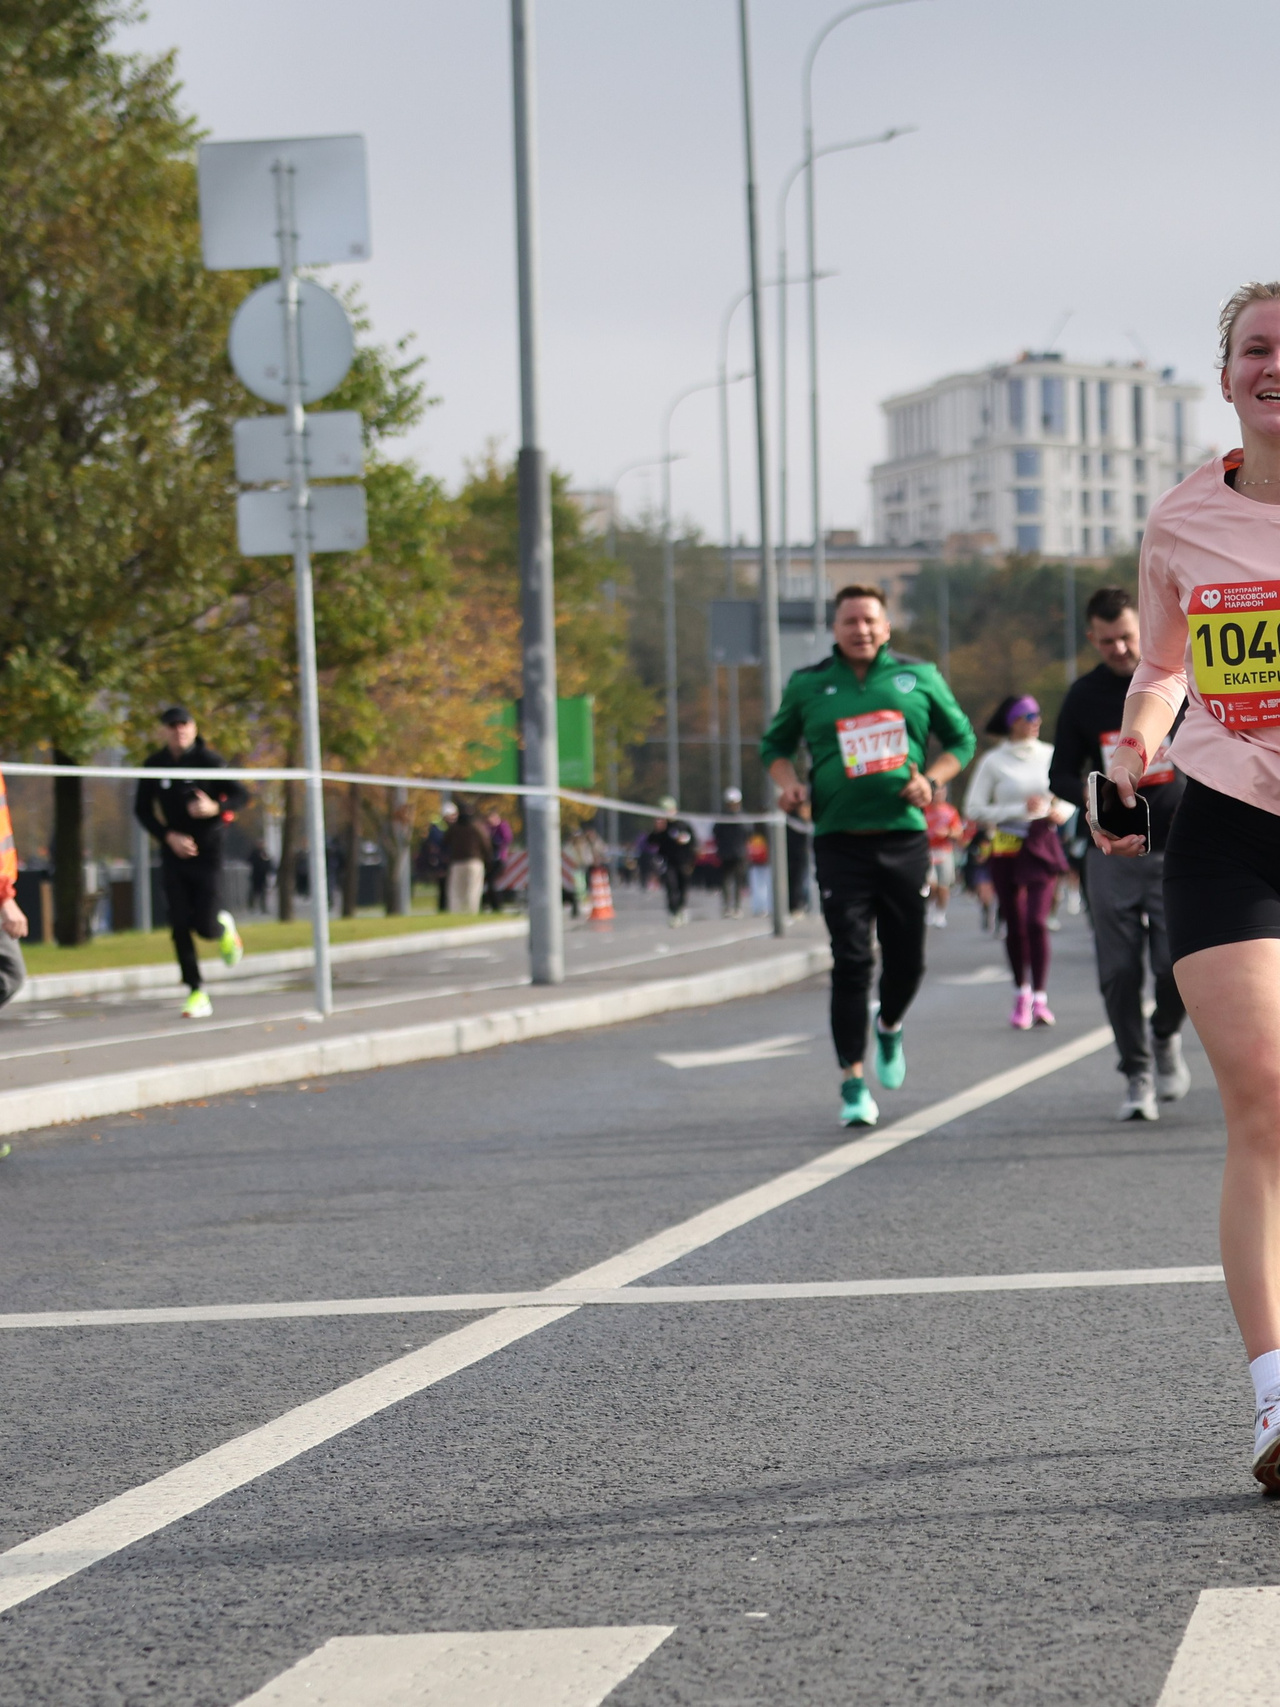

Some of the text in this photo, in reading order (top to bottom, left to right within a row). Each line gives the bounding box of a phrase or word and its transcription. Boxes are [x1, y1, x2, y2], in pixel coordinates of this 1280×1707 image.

[1224, 586, 1263, 594] СБЕРПРАЙМ
[1224, 591, 1278, 602] МОСКОВСКИЙ
[1224, 600, 1264, 609] МАРАФОН
[846, 729, 904, 756] 31777
